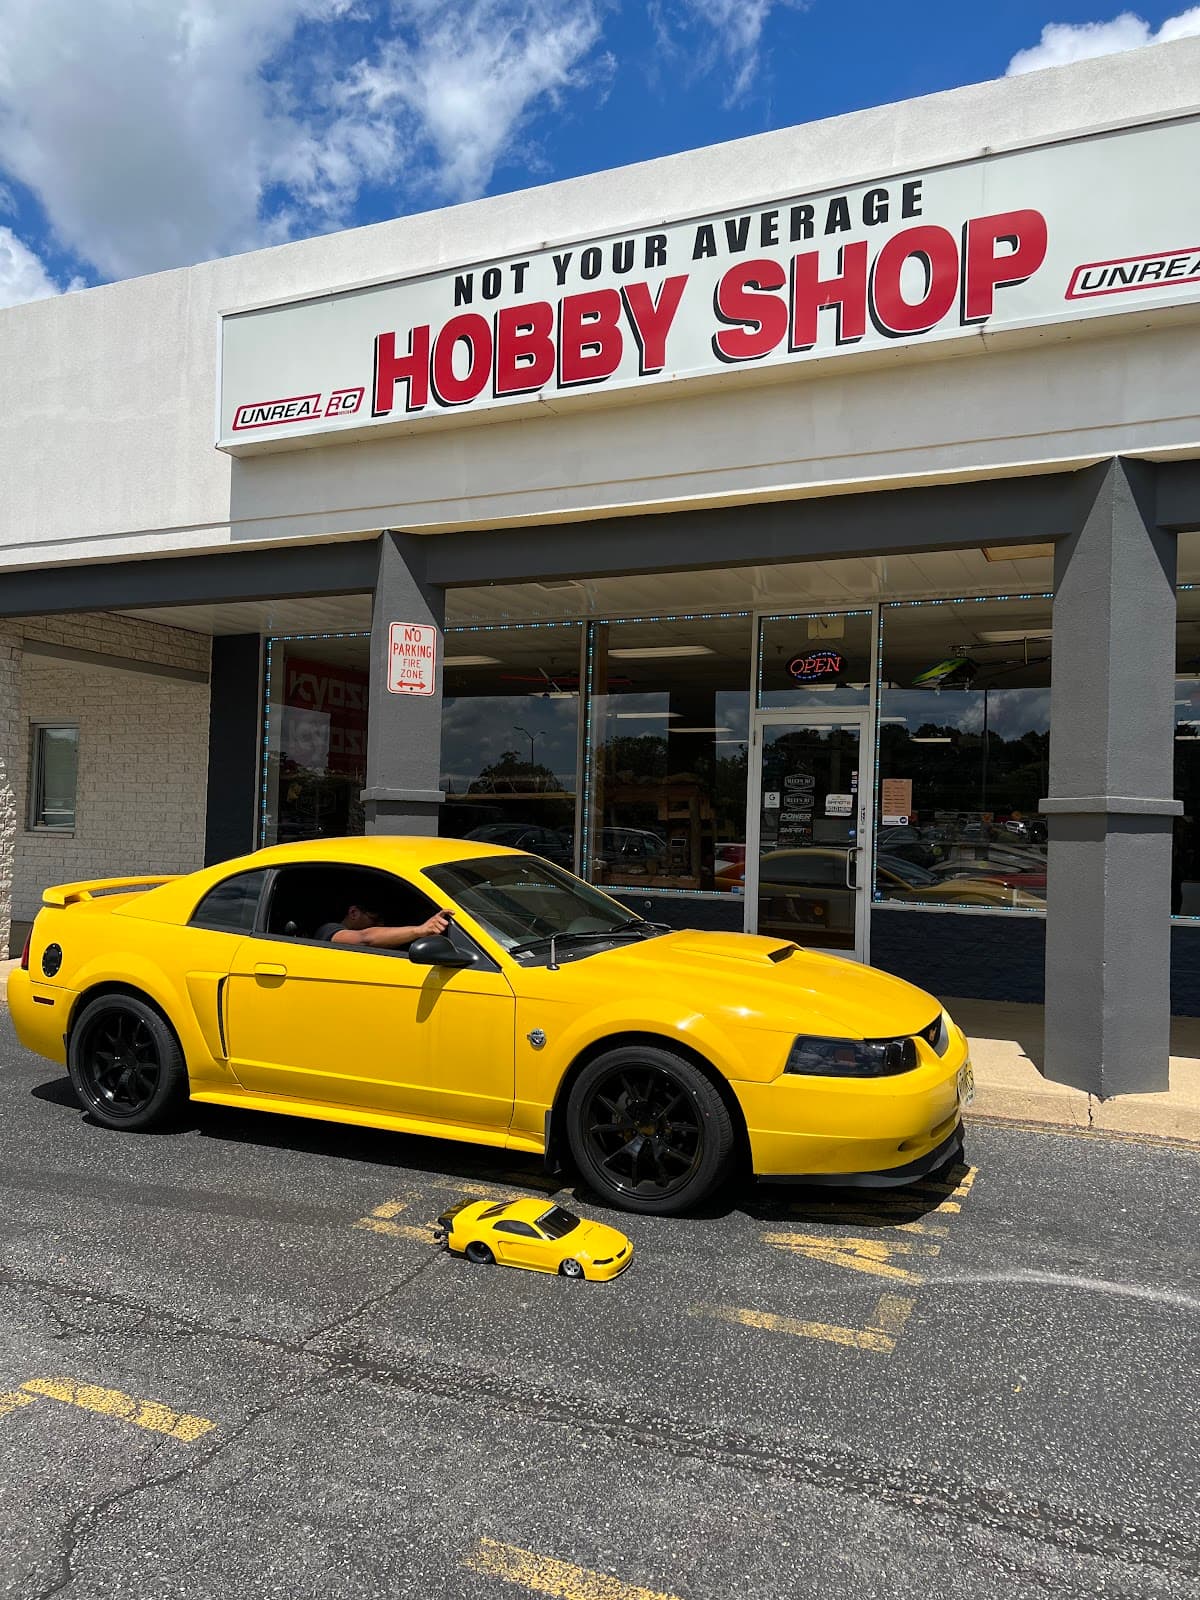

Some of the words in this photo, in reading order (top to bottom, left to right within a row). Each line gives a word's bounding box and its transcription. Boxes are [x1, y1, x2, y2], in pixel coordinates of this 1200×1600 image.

[454, 262, 530, 306] NOT
[553, 229, 668, 286] YOUR
[692, 180, 924, 260] AVERAGE
[371, 274, 689, 418] HOBBY
[711, 208, 1048, 364] SHOP
[240, 393, 322, 424] UNREAL
[325, 394, 357, 416] RC
[405, 628, 422, 642] NO
[394, 643, 432, 658] PARKING
[403, 659, 421, 668] FIRE
[790, 657, 842, 674] OPEN
[401, 669, 423, 679] ZONE
